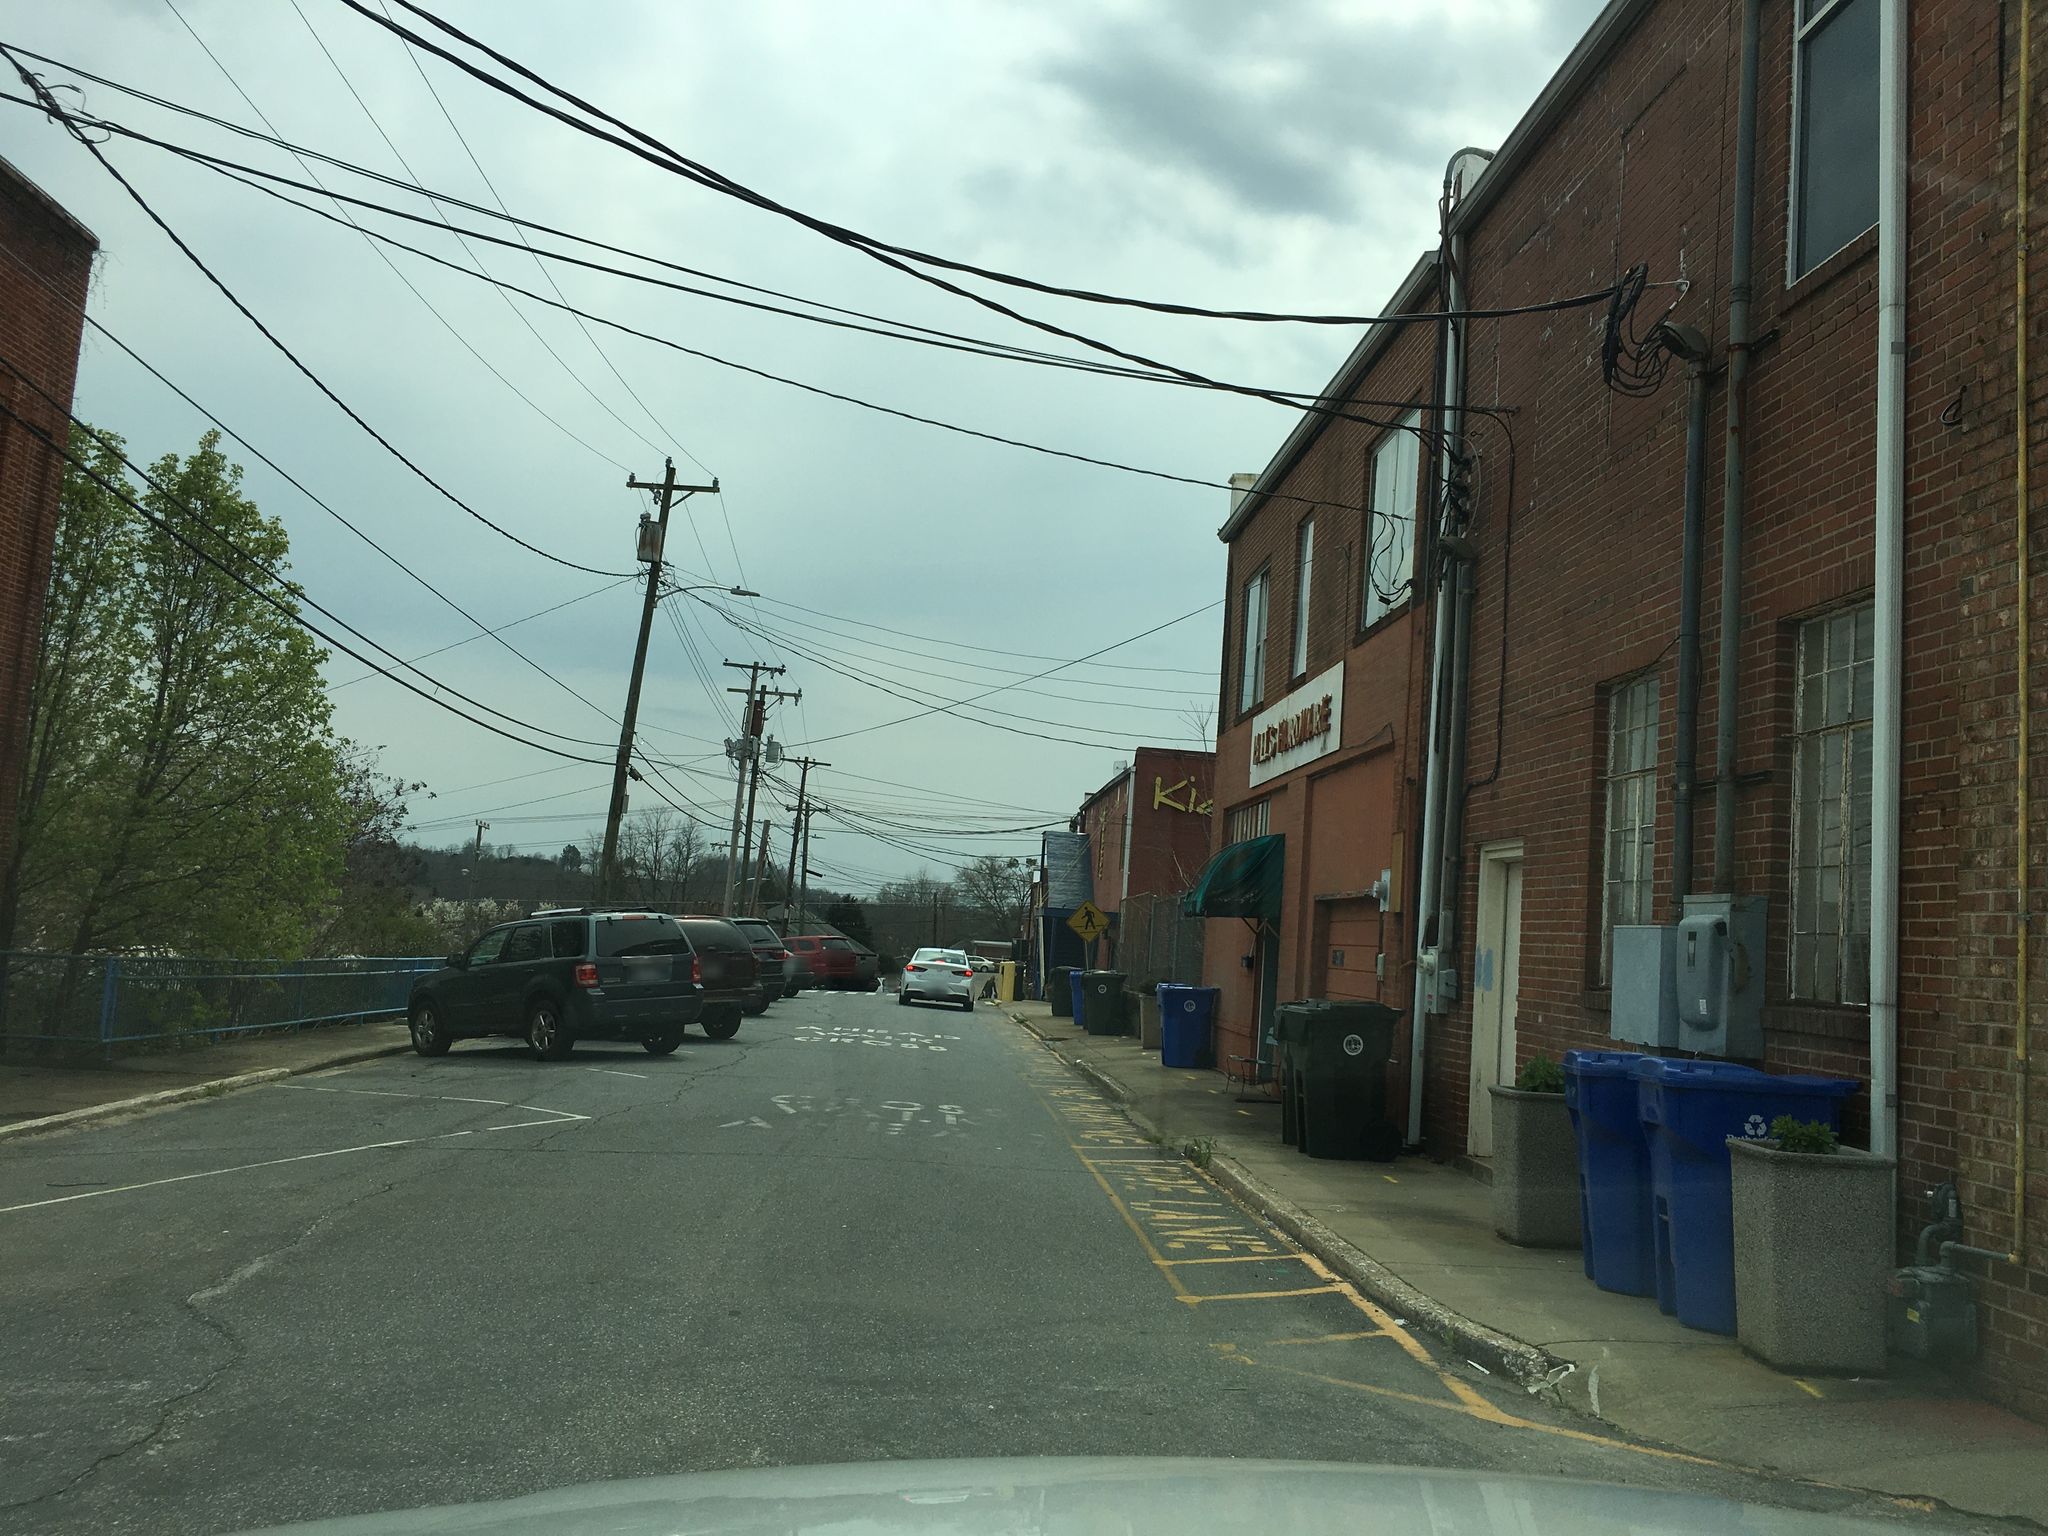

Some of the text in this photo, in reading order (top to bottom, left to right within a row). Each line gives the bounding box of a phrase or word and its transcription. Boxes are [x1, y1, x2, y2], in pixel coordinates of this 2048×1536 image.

[795, 1026, 961, 1040] AHEAD
[794, 1037, 948, 1051] CROSS
[1130, 1200, 1275, 1253] LANE
